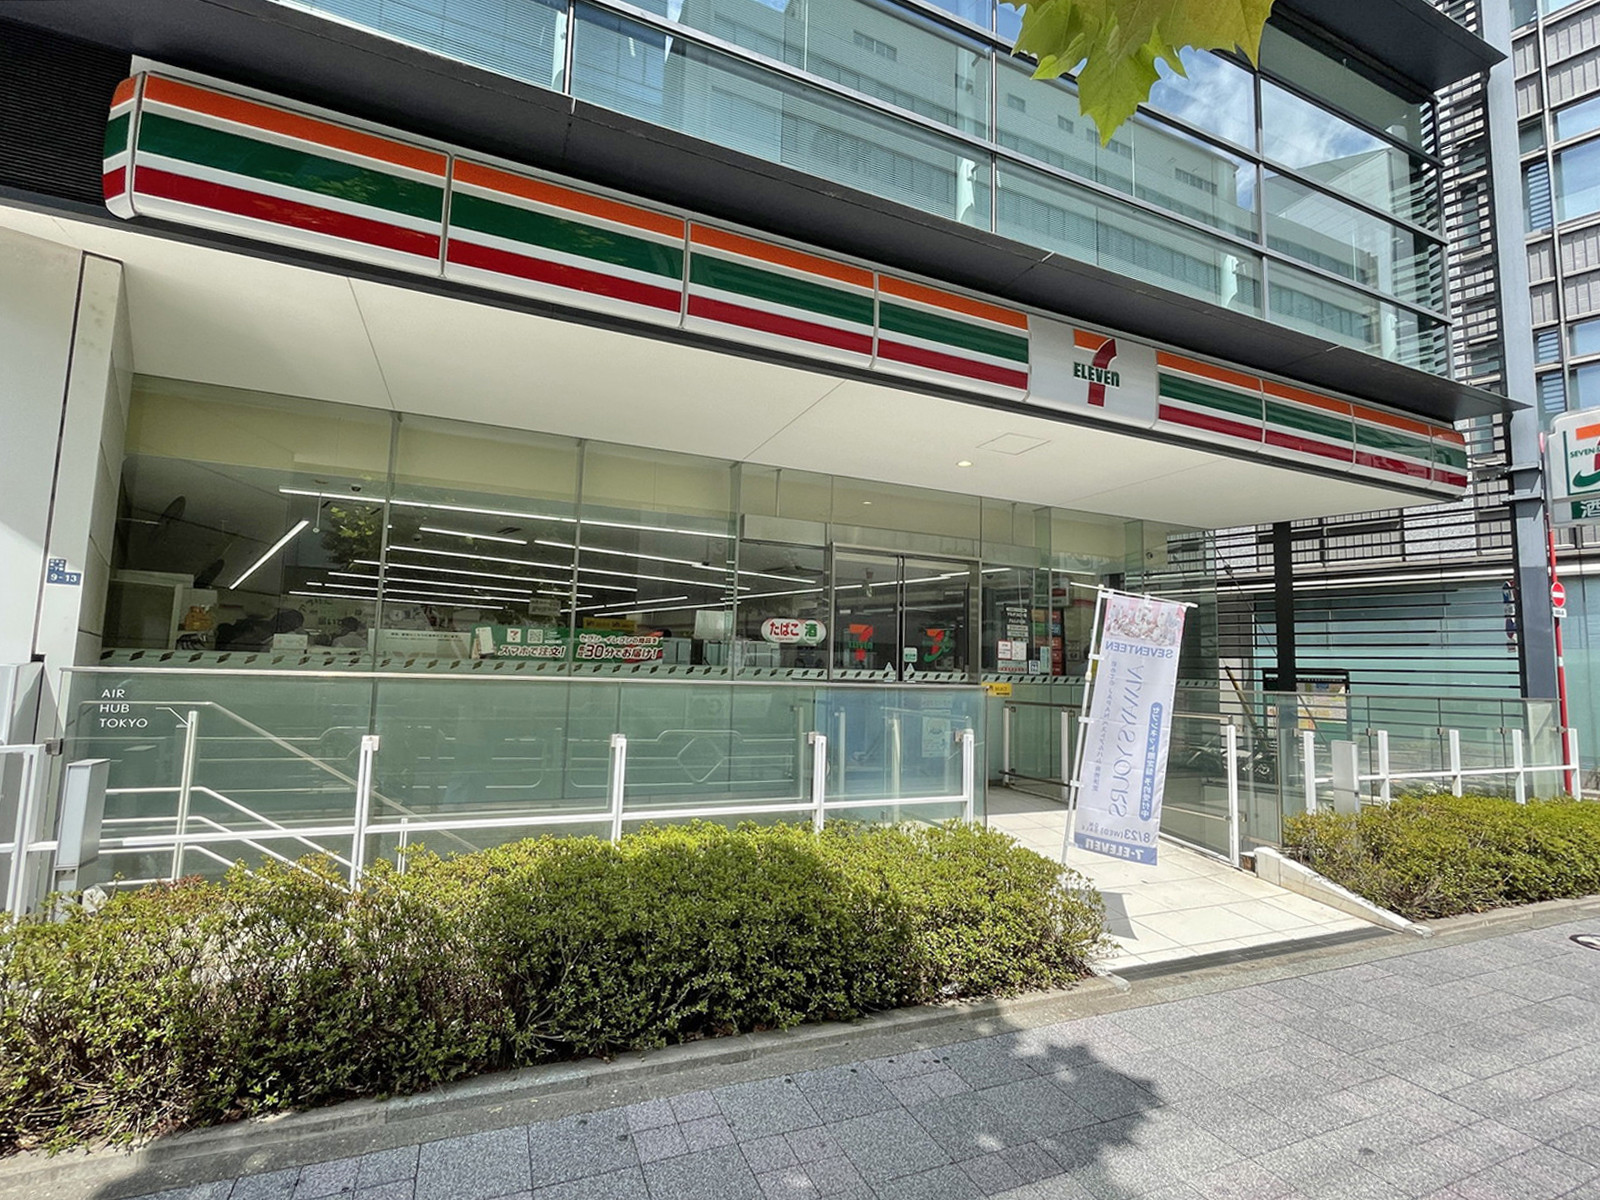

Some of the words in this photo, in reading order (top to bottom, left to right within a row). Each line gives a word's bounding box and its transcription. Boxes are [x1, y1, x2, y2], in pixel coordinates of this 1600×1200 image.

[769, 621, 799, 636] たばこ
[805, 623, 817, 637] 酒
[101, 688, 125, 698] AIR
[99, 703, 130, 713] HUB
[99, 718, 148, 728] TOKYO
